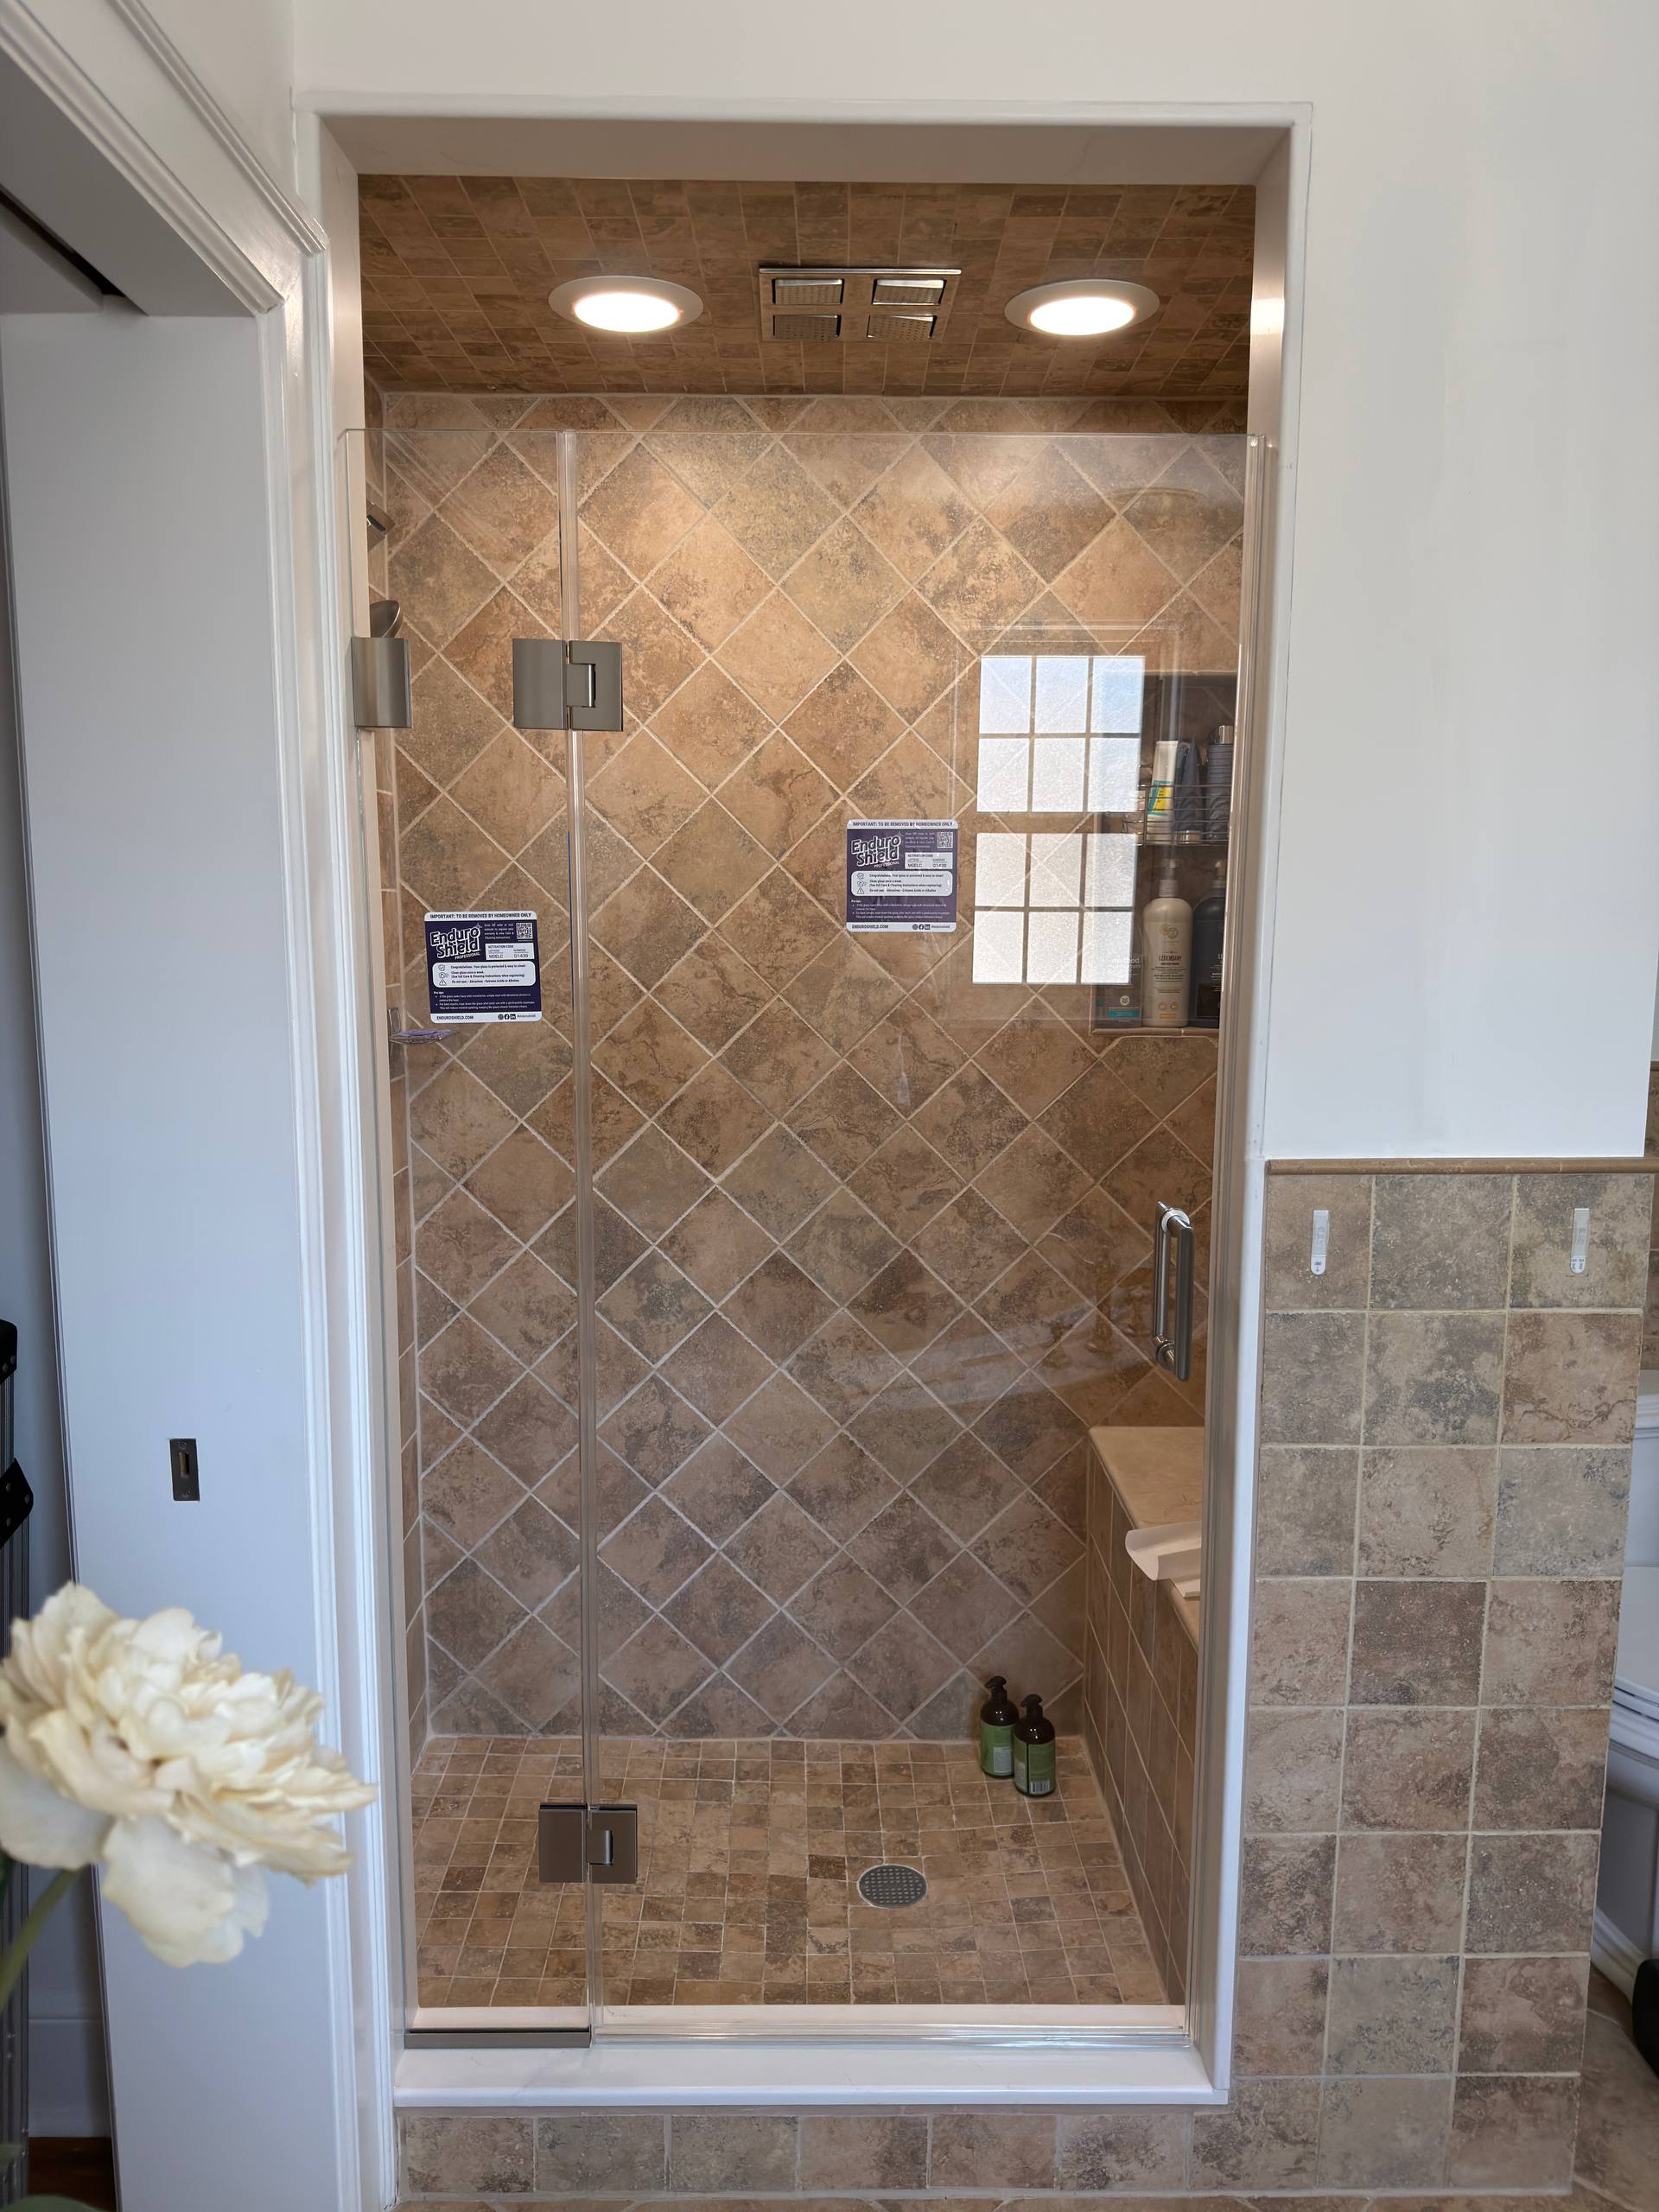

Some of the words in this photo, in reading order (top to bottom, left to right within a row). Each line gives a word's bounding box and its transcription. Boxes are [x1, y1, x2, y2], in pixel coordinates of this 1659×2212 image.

[851, 835, 901, 855] Enduro
[857, 847, 899, 866] Shield
[430, 927, 480, 946] Enduro
[436, 938, 479, 958] Shield
[1112, 955, 1139, 964] mthod
